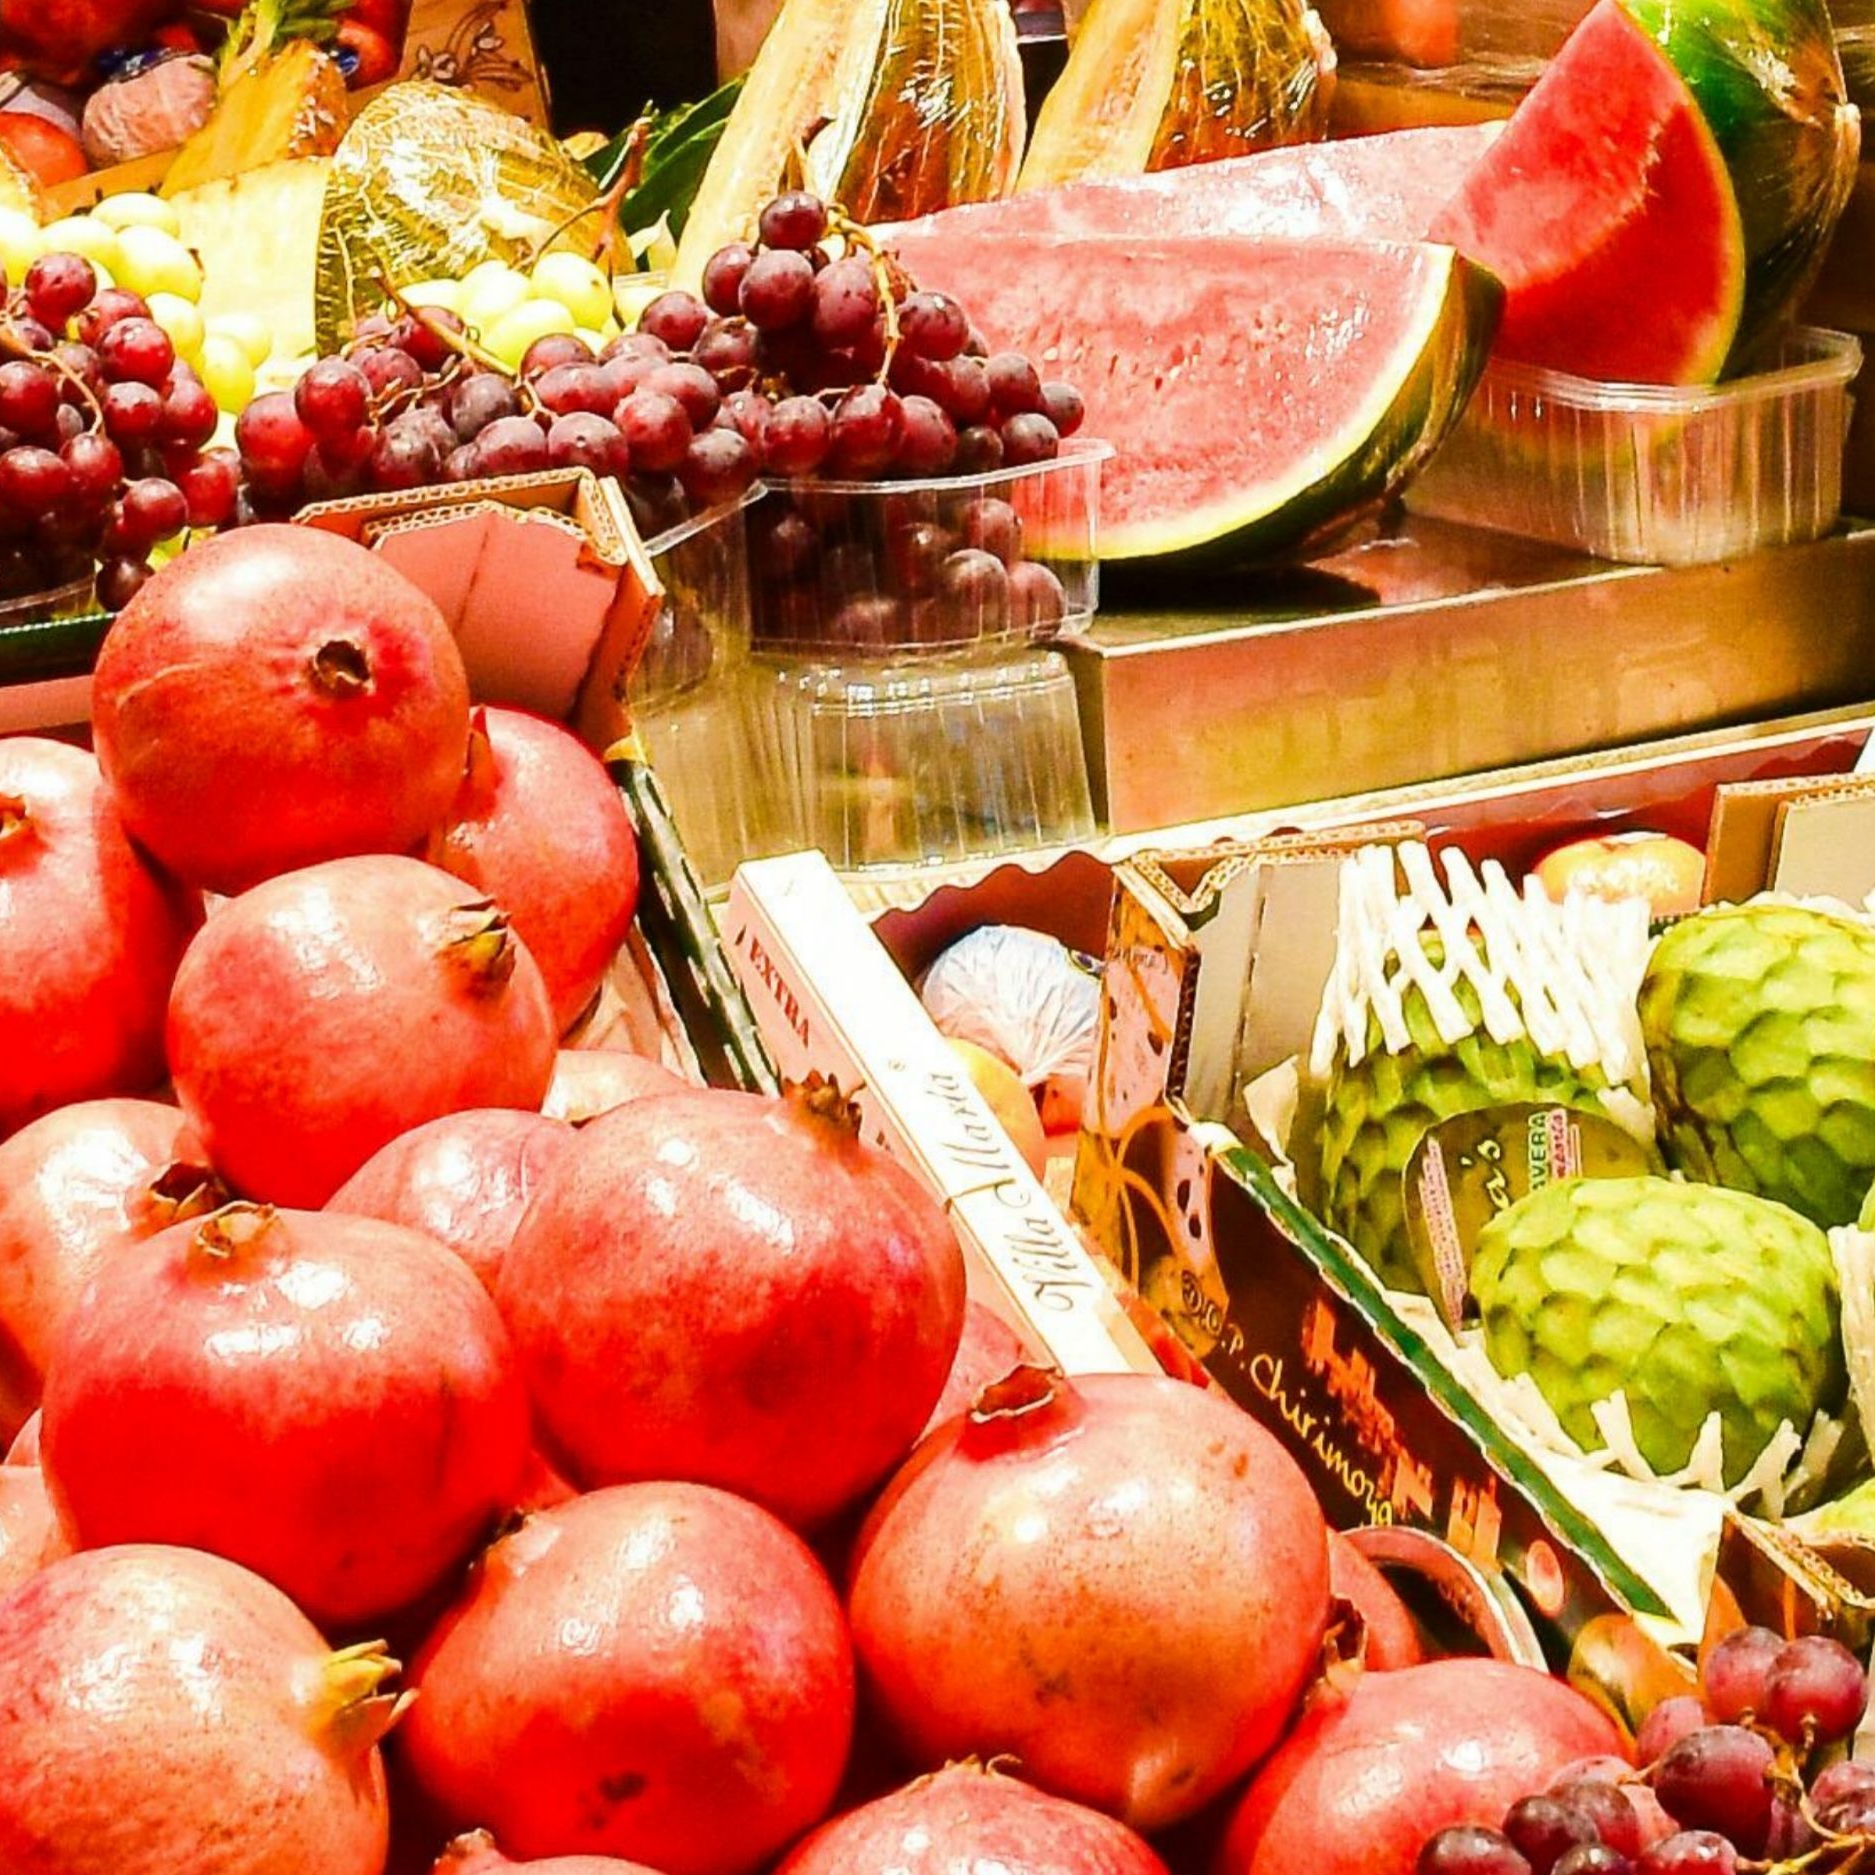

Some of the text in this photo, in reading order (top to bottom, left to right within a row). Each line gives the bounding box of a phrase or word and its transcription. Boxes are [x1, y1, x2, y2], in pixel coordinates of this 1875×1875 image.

[748, 937, 809, 1049] EXTRA
[1004, 1216, 1094, 1312] Villa
[1250, 1352, 1393, 1527] Chirimoya
